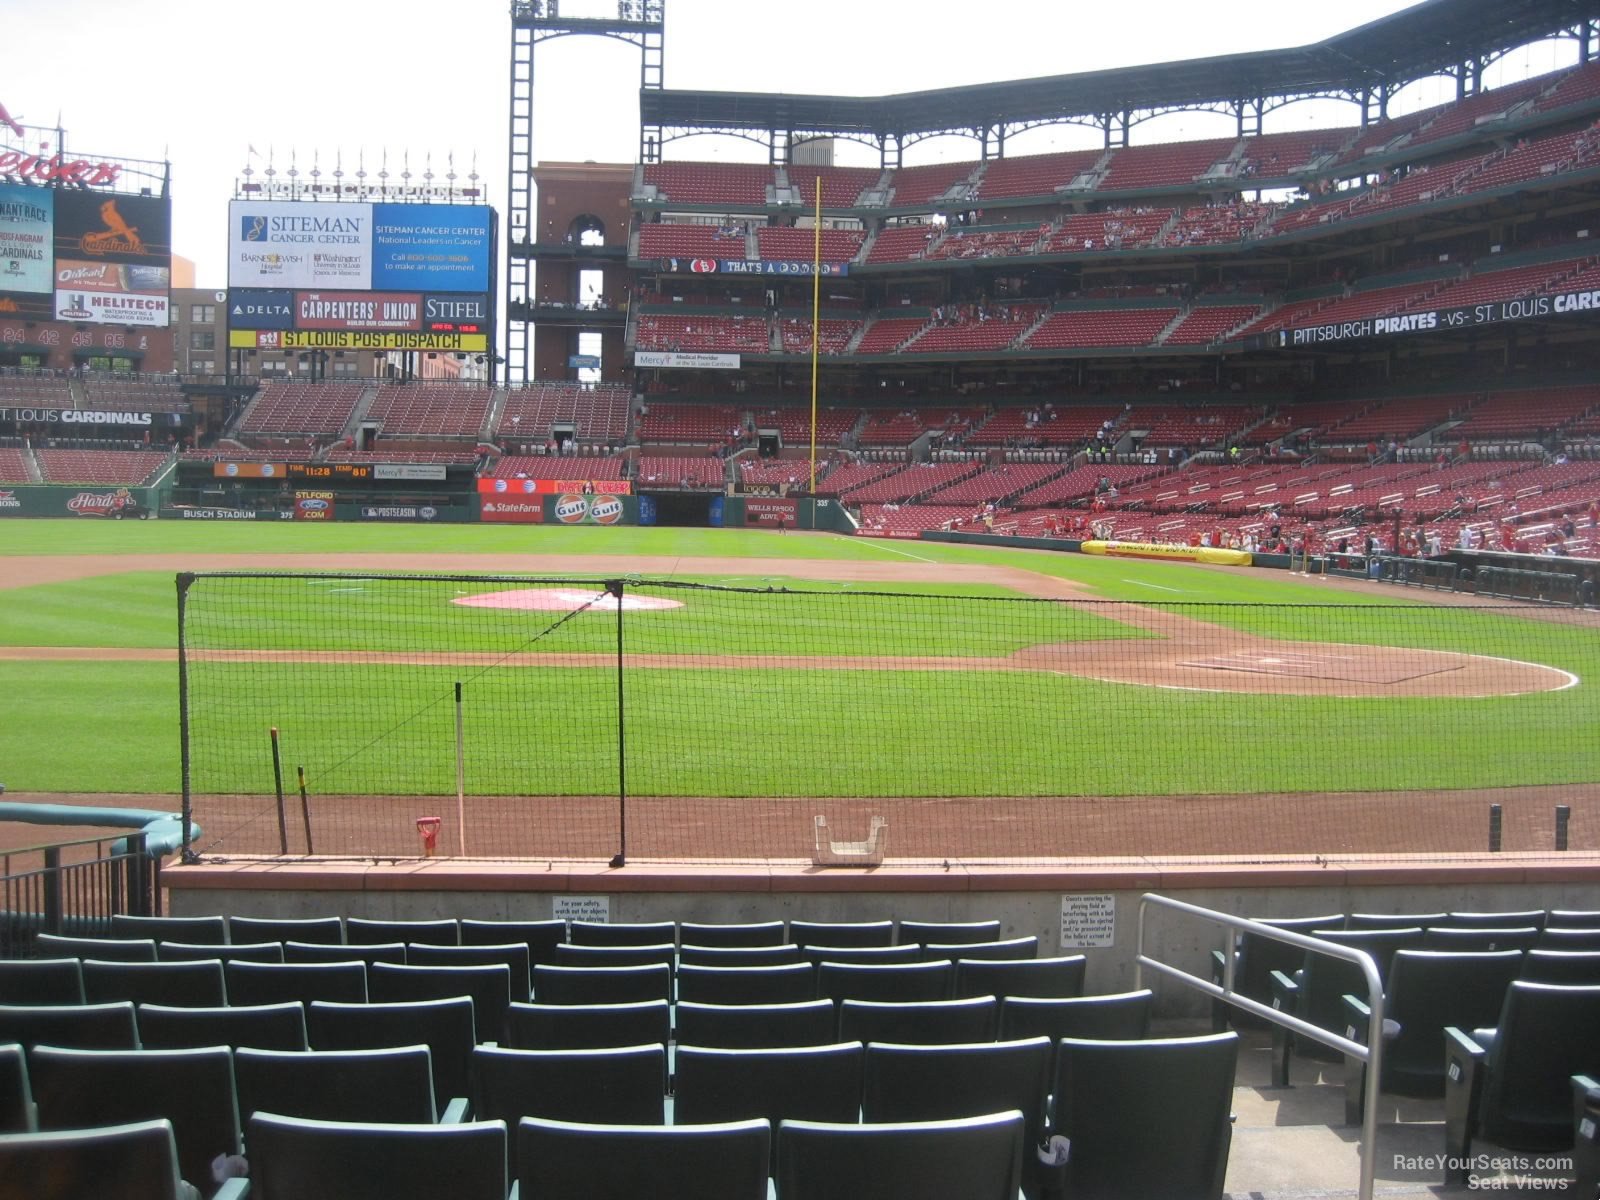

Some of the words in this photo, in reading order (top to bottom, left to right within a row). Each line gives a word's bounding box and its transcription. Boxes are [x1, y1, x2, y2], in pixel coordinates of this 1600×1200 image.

[259, 181, 336, 195] WORLD
[341, 185, 464, 197] CHAMPIONS
[25, 205, 47, 222] RACE
[271, 217, 360, 232] SITEMAN
[271, 234, 315, 243] CANCER
[318, 235, 360, 244] CENTER
[378, 236, 411, 244] National
[413, 237, 443, 245] Leaders
[428, 264, 475, 272] appointment
[728, 261, 762, 272] THAT'S
[767, 263, 775, 272] A
[91, 296, 165, 311] HELITECH
[247, 306, 290, 314] DELTA
[301, 301, 378, 319] CARPENTERS'
[384, 302, 417, 320] UNION
[426, 299, 484, 318] STIFEL
[1294, 321, 1371, 344] PITTSBURGH
[1374, 312, 1436, 334] PIRATES
[1475, 304, 1495, 322] ST.
[1502, 298, 1549, 319] LOUIS
[4, 328, 25, 343] 24
[39, 329, 60, 345] 42
[71, 332, 92, 347] 45
[104, 334, 124, 348] 85
[285, 331, 304, 346] ST.
[308, 332, 347, 346] LOUIS
[353, 333, 460, 348] POST-DISPATCH
[640, 356, 664, 365] Mercy
[16, 409, 58, 422] LOUIS
[62, 411, 152, 424] CARDINALS
[306, 467, 330, 476] 11:28
[295, 491, 333, 499] STLFORD
[184, 510, 214, 518] BUSCH
[217, 510, 255, 519] STADIUM
[378, 507, 416, 517] POSTSEASON
[557, 502, 586, 516] Gulf
[592, 502, 620, 516] Gulf
